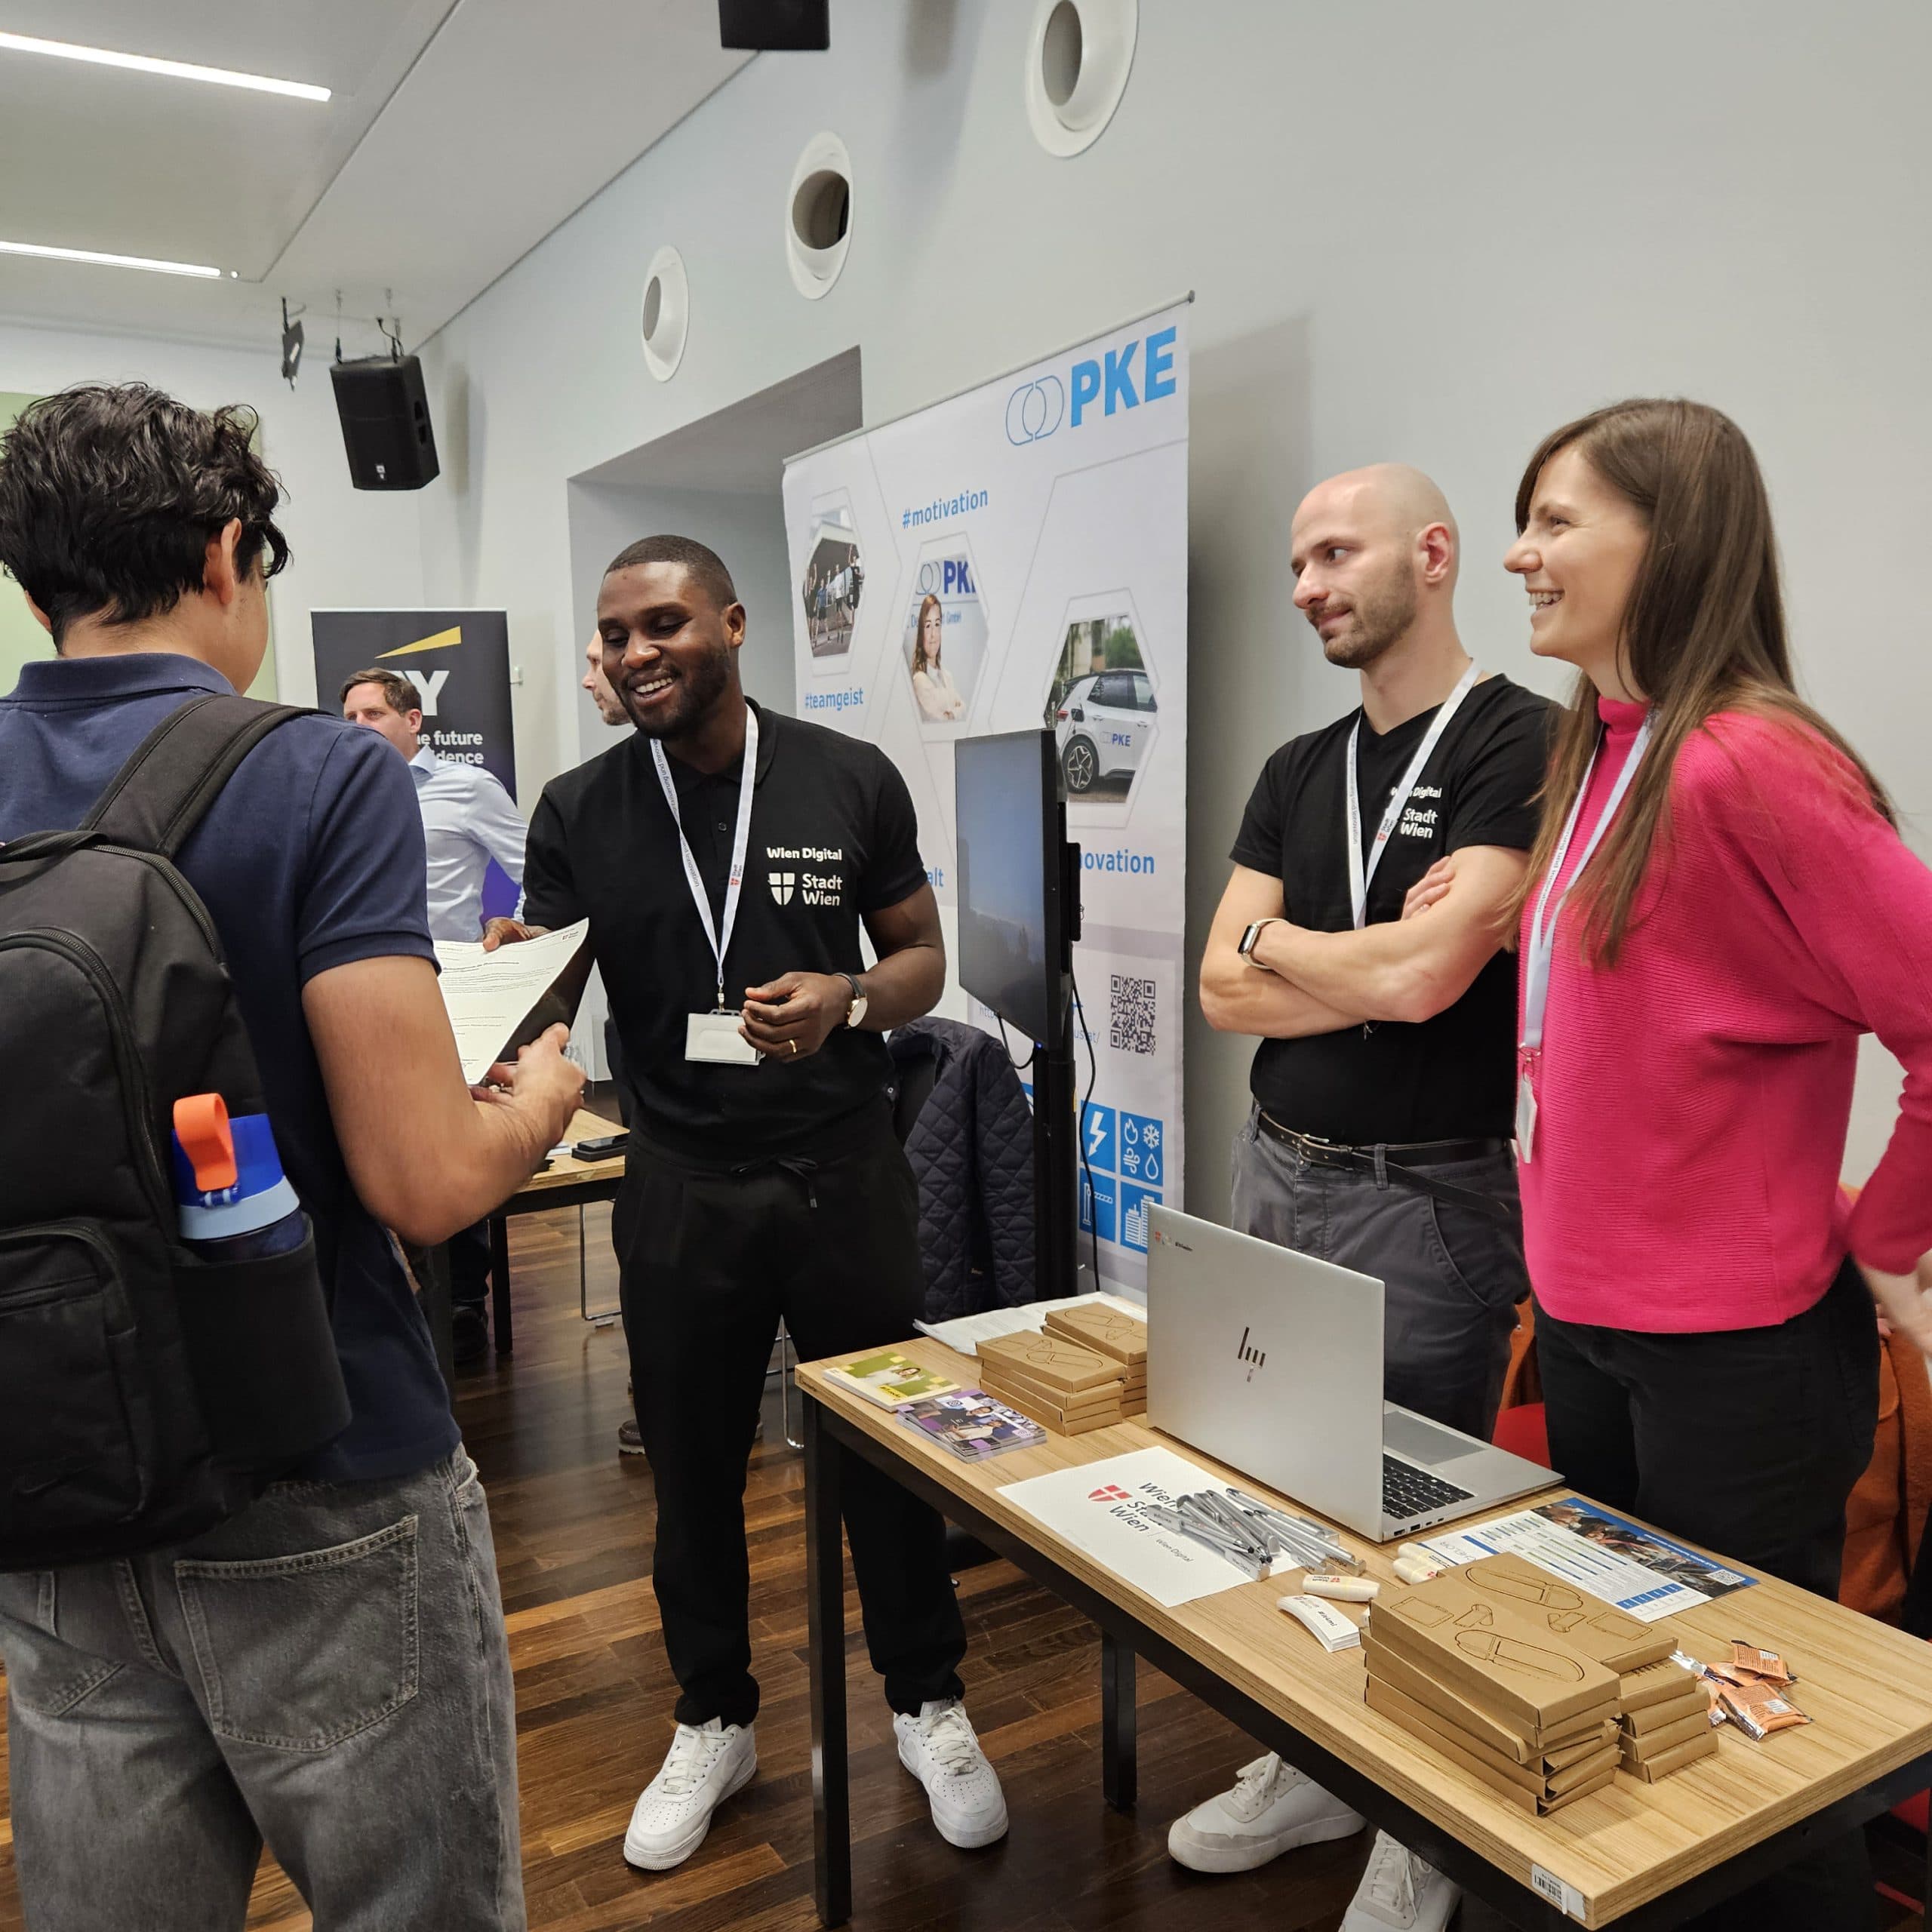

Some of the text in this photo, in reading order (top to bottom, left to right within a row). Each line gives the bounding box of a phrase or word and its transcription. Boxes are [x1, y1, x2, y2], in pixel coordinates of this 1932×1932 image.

[1071, 326, 1177, 428] PKE
[903, 490, 988, 529] #motivation
[943, 560, 976, 594] PK
[388, 670, 450, 716] Y
[805, 688, 863, 711] #teamgeist
[434, 731, 483, 745] future
[1112, 733, 1131, 747] PKE
[1413, 786, 1442, 798] Digital
[1403, 808, 1438, 824] Stadt
[1401, 822, 1433, 838] Wien
[766, 847, 842, 862] Wien Digital
[1080, 849, 1155, 874] ovation
[802, 873, 843, 890] Stadt
[802, 890, 840, 906] Wien
[1138, 1482, 1177, 1508] Wien
[1127, 1500, 1148, 1518] Sta
[1109, 1505, 1150, 1532] Wien
